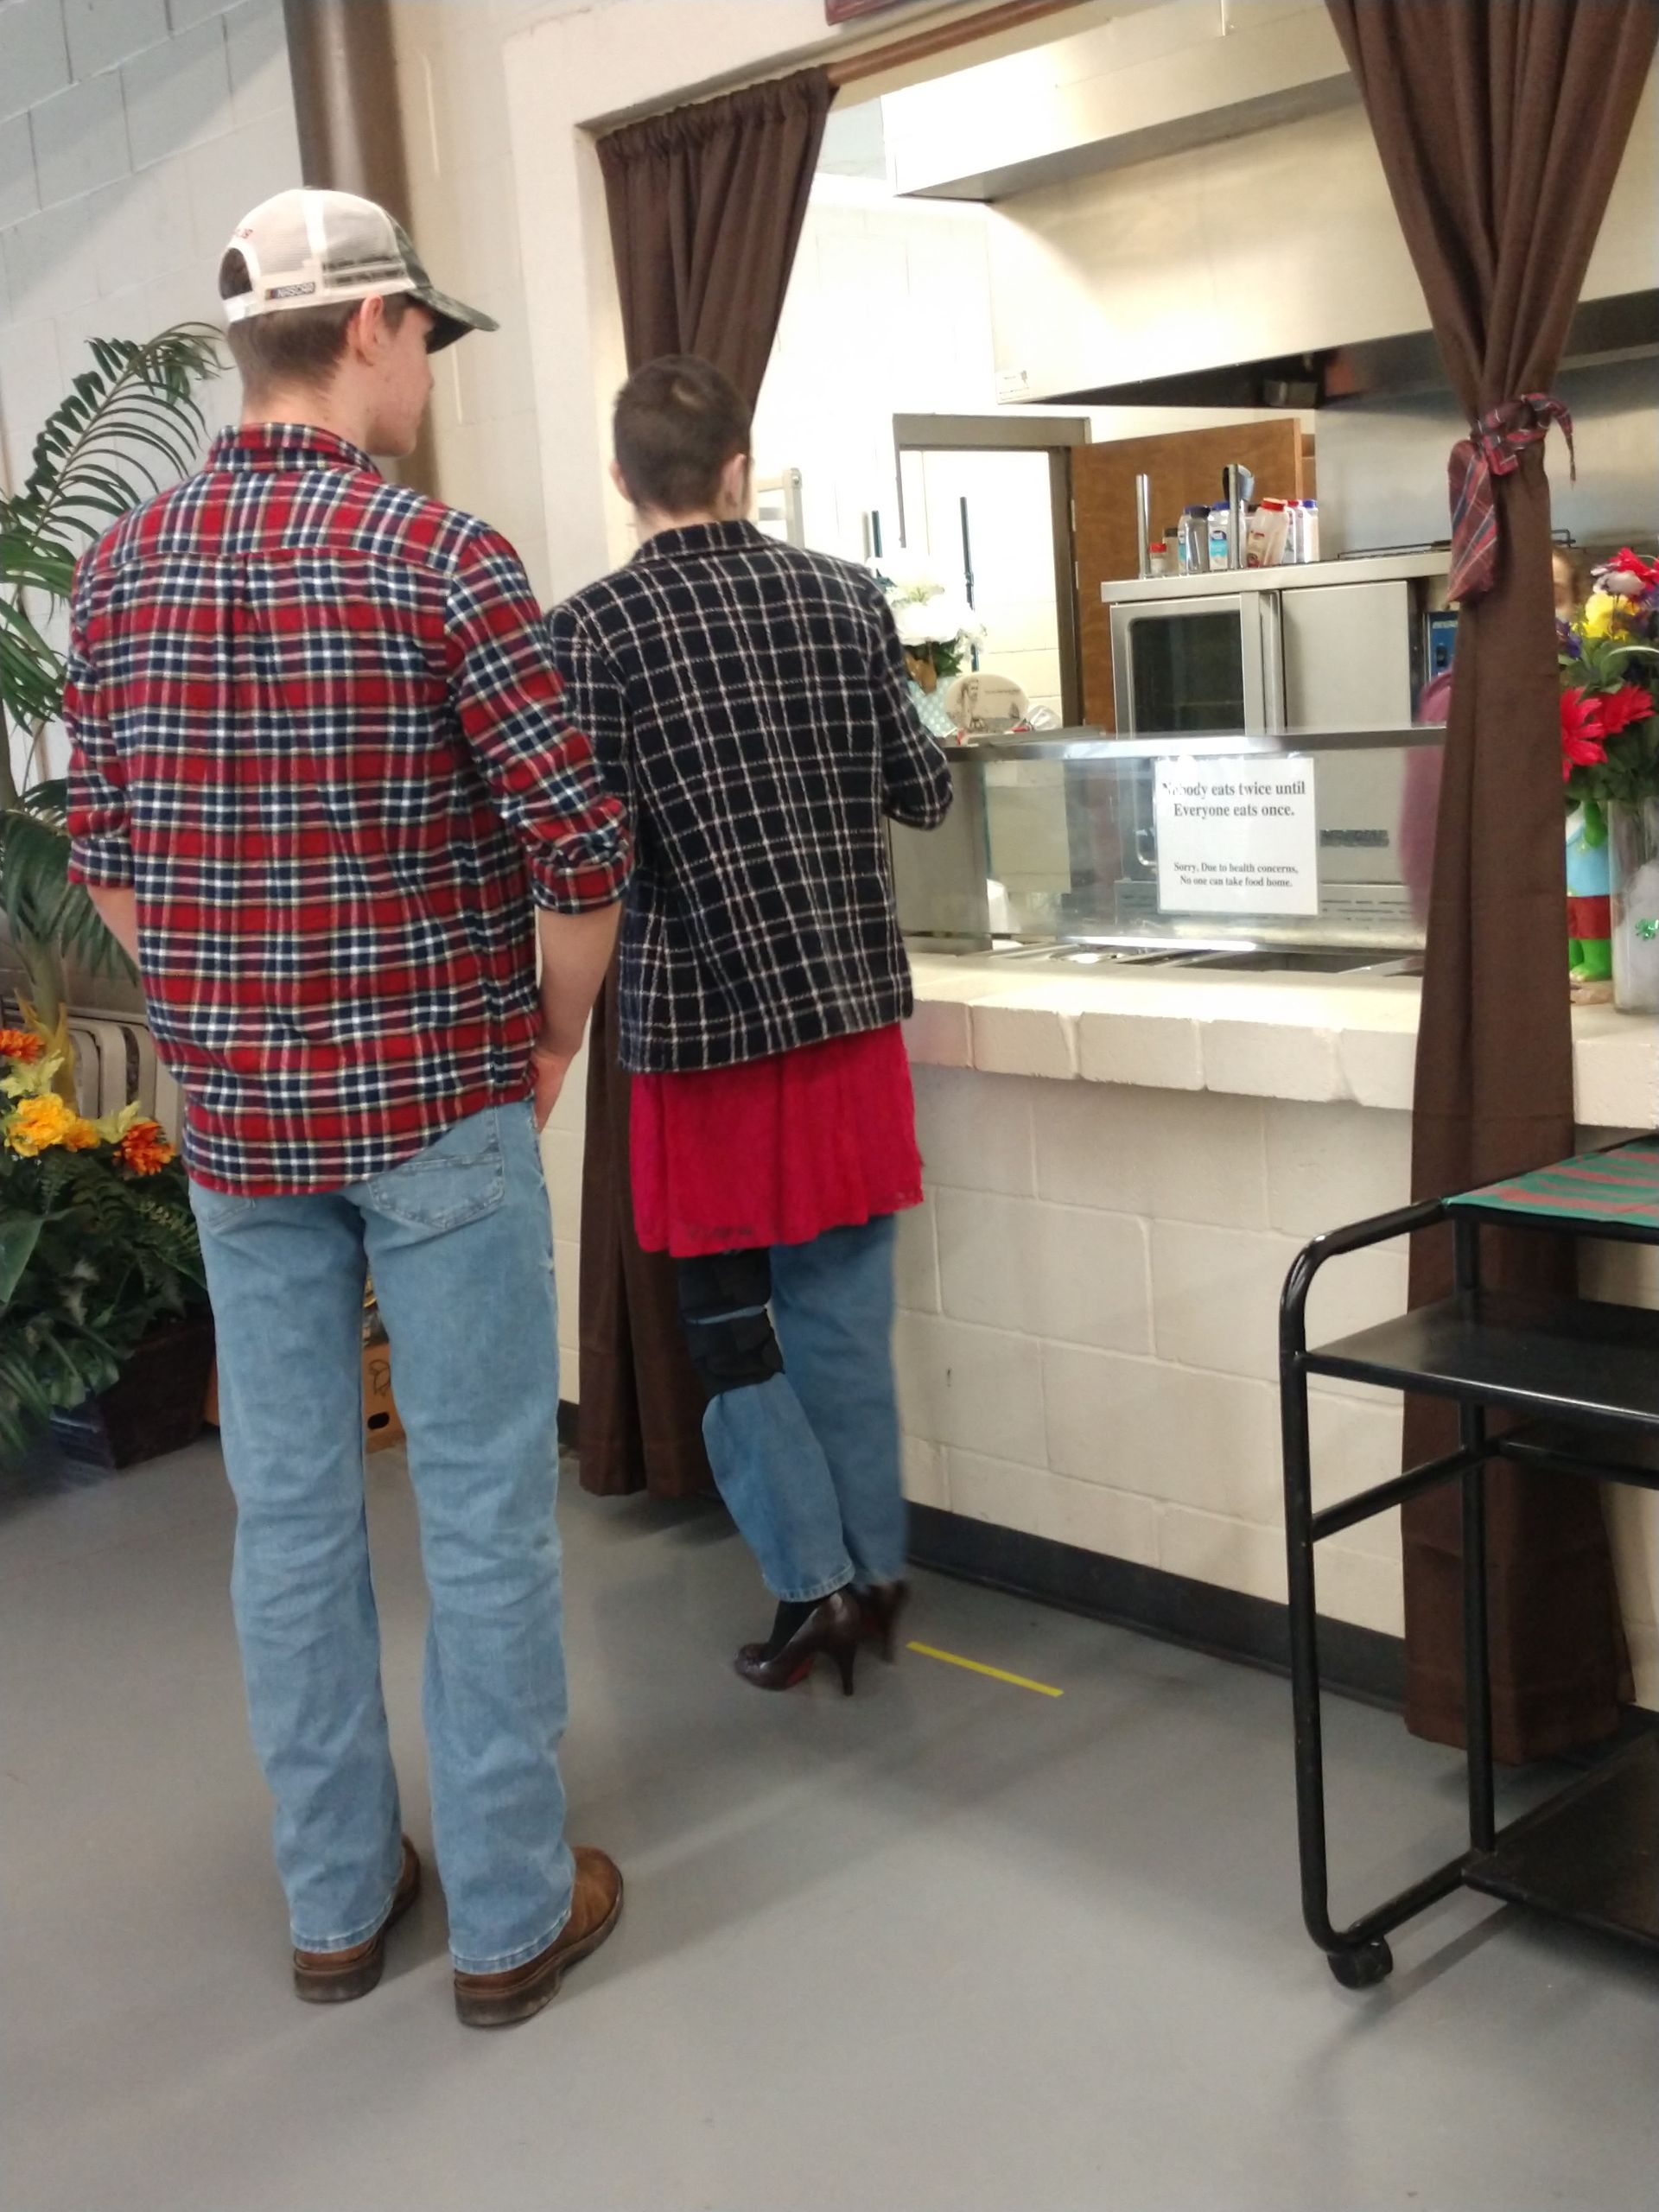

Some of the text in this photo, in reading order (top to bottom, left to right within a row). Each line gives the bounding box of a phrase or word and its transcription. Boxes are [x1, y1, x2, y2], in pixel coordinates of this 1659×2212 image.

[1162, 780, 1306, 799] Nody eats twice until
[1173, 803, 1295, 819] Everyone eats once.
[1201, 862, 1217, 872] Due
[1219, 863, 1227, 872] to
[1229, 862, 1255, 873] health
[1180, 874, 1293, 887] No one can take food home.
